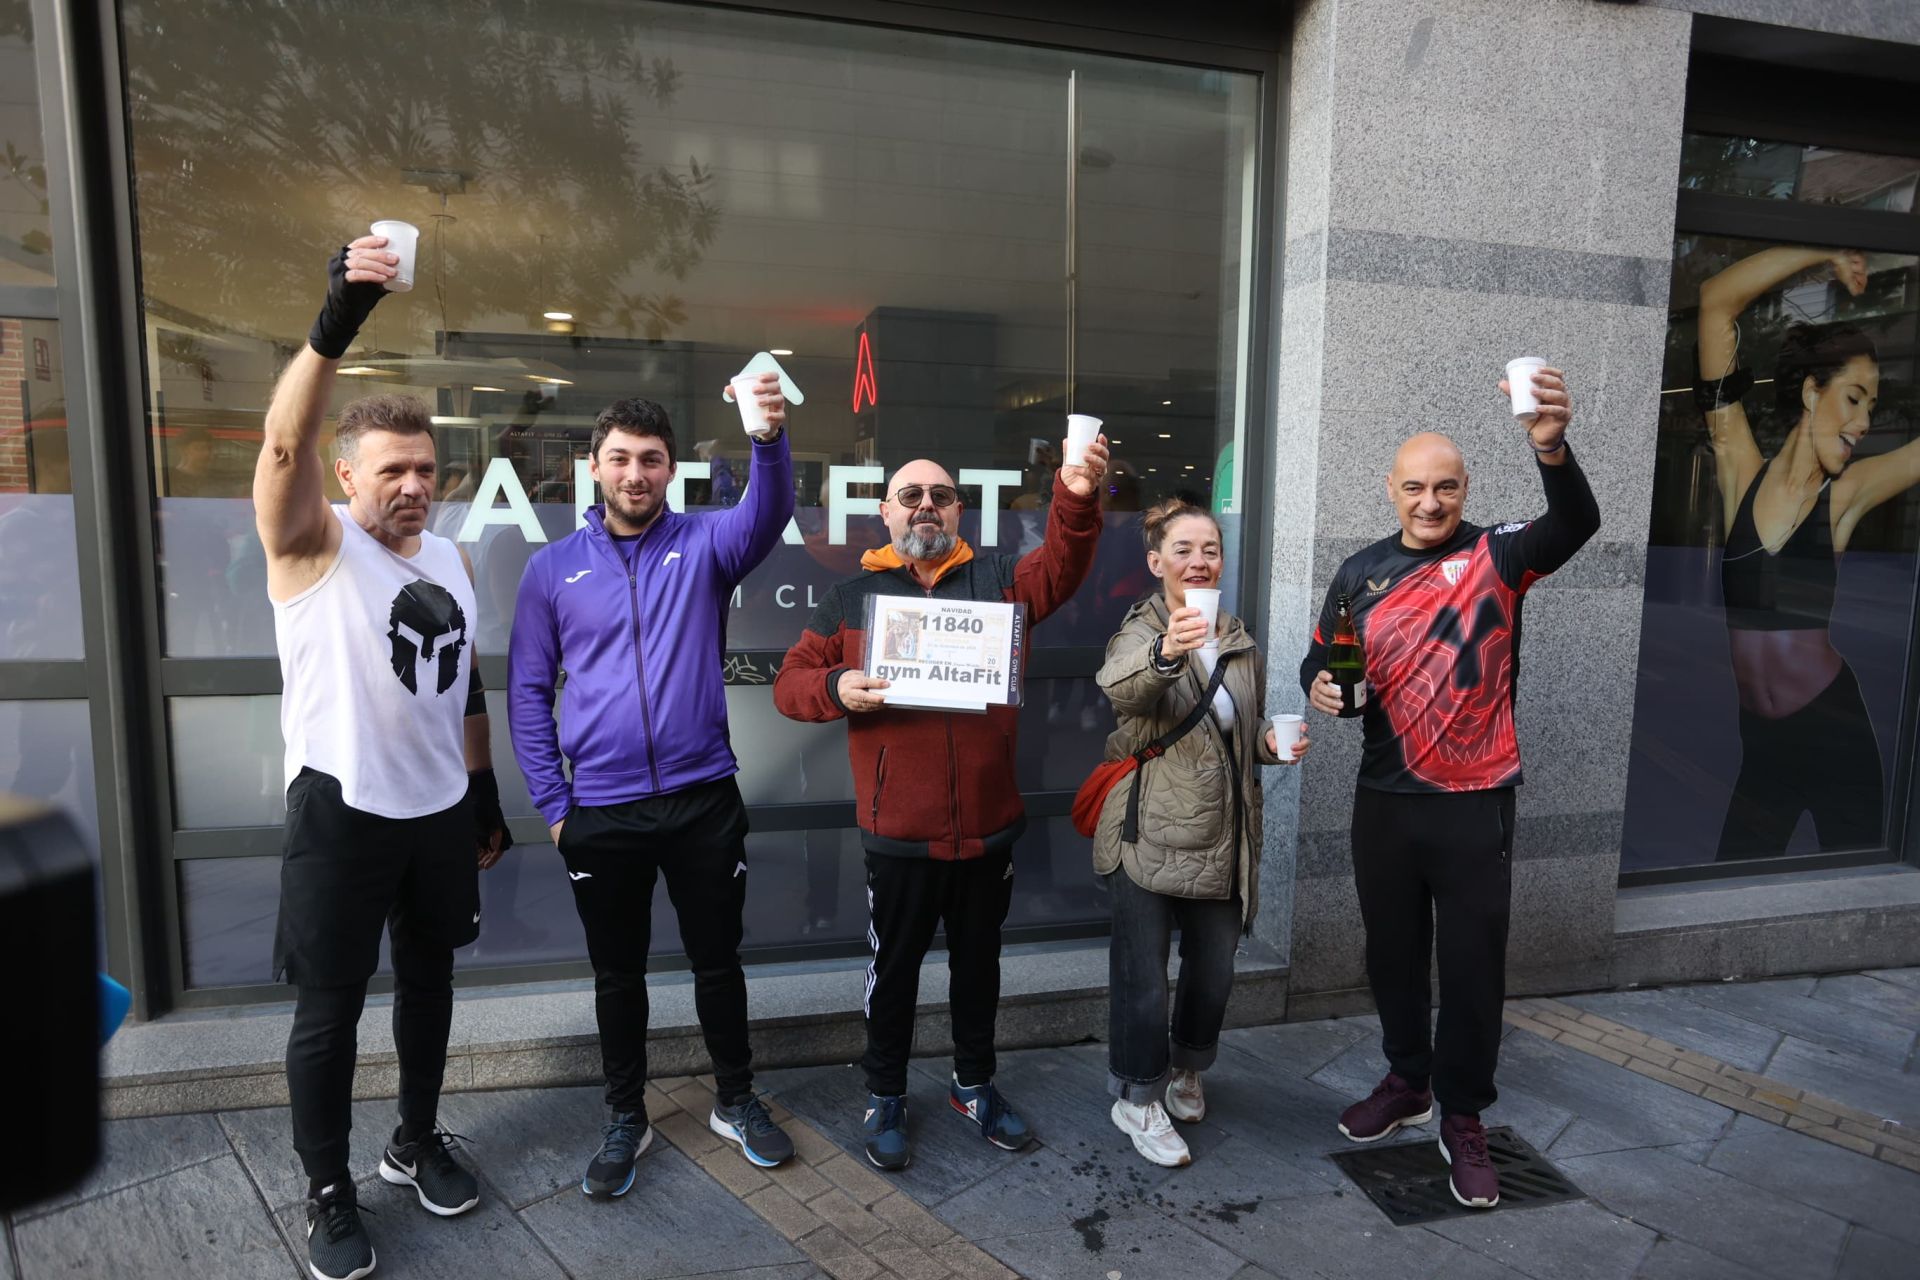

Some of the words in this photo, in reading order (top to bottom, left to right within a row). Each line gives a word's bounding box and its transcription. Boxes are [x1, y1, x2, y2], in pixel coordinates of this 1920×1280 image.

[941, 607, 972, 615] NAVIDAD
[918, 615, 984, 634] 11840
[1013, 614, 1021, 648] ALTAFIT
[987, 656, 996, 665] 20
[876, 664, 921, 681] gym
[928, 665, 1002, 686] AltaFit
[1010, 676, 1018, 692] CLUB
